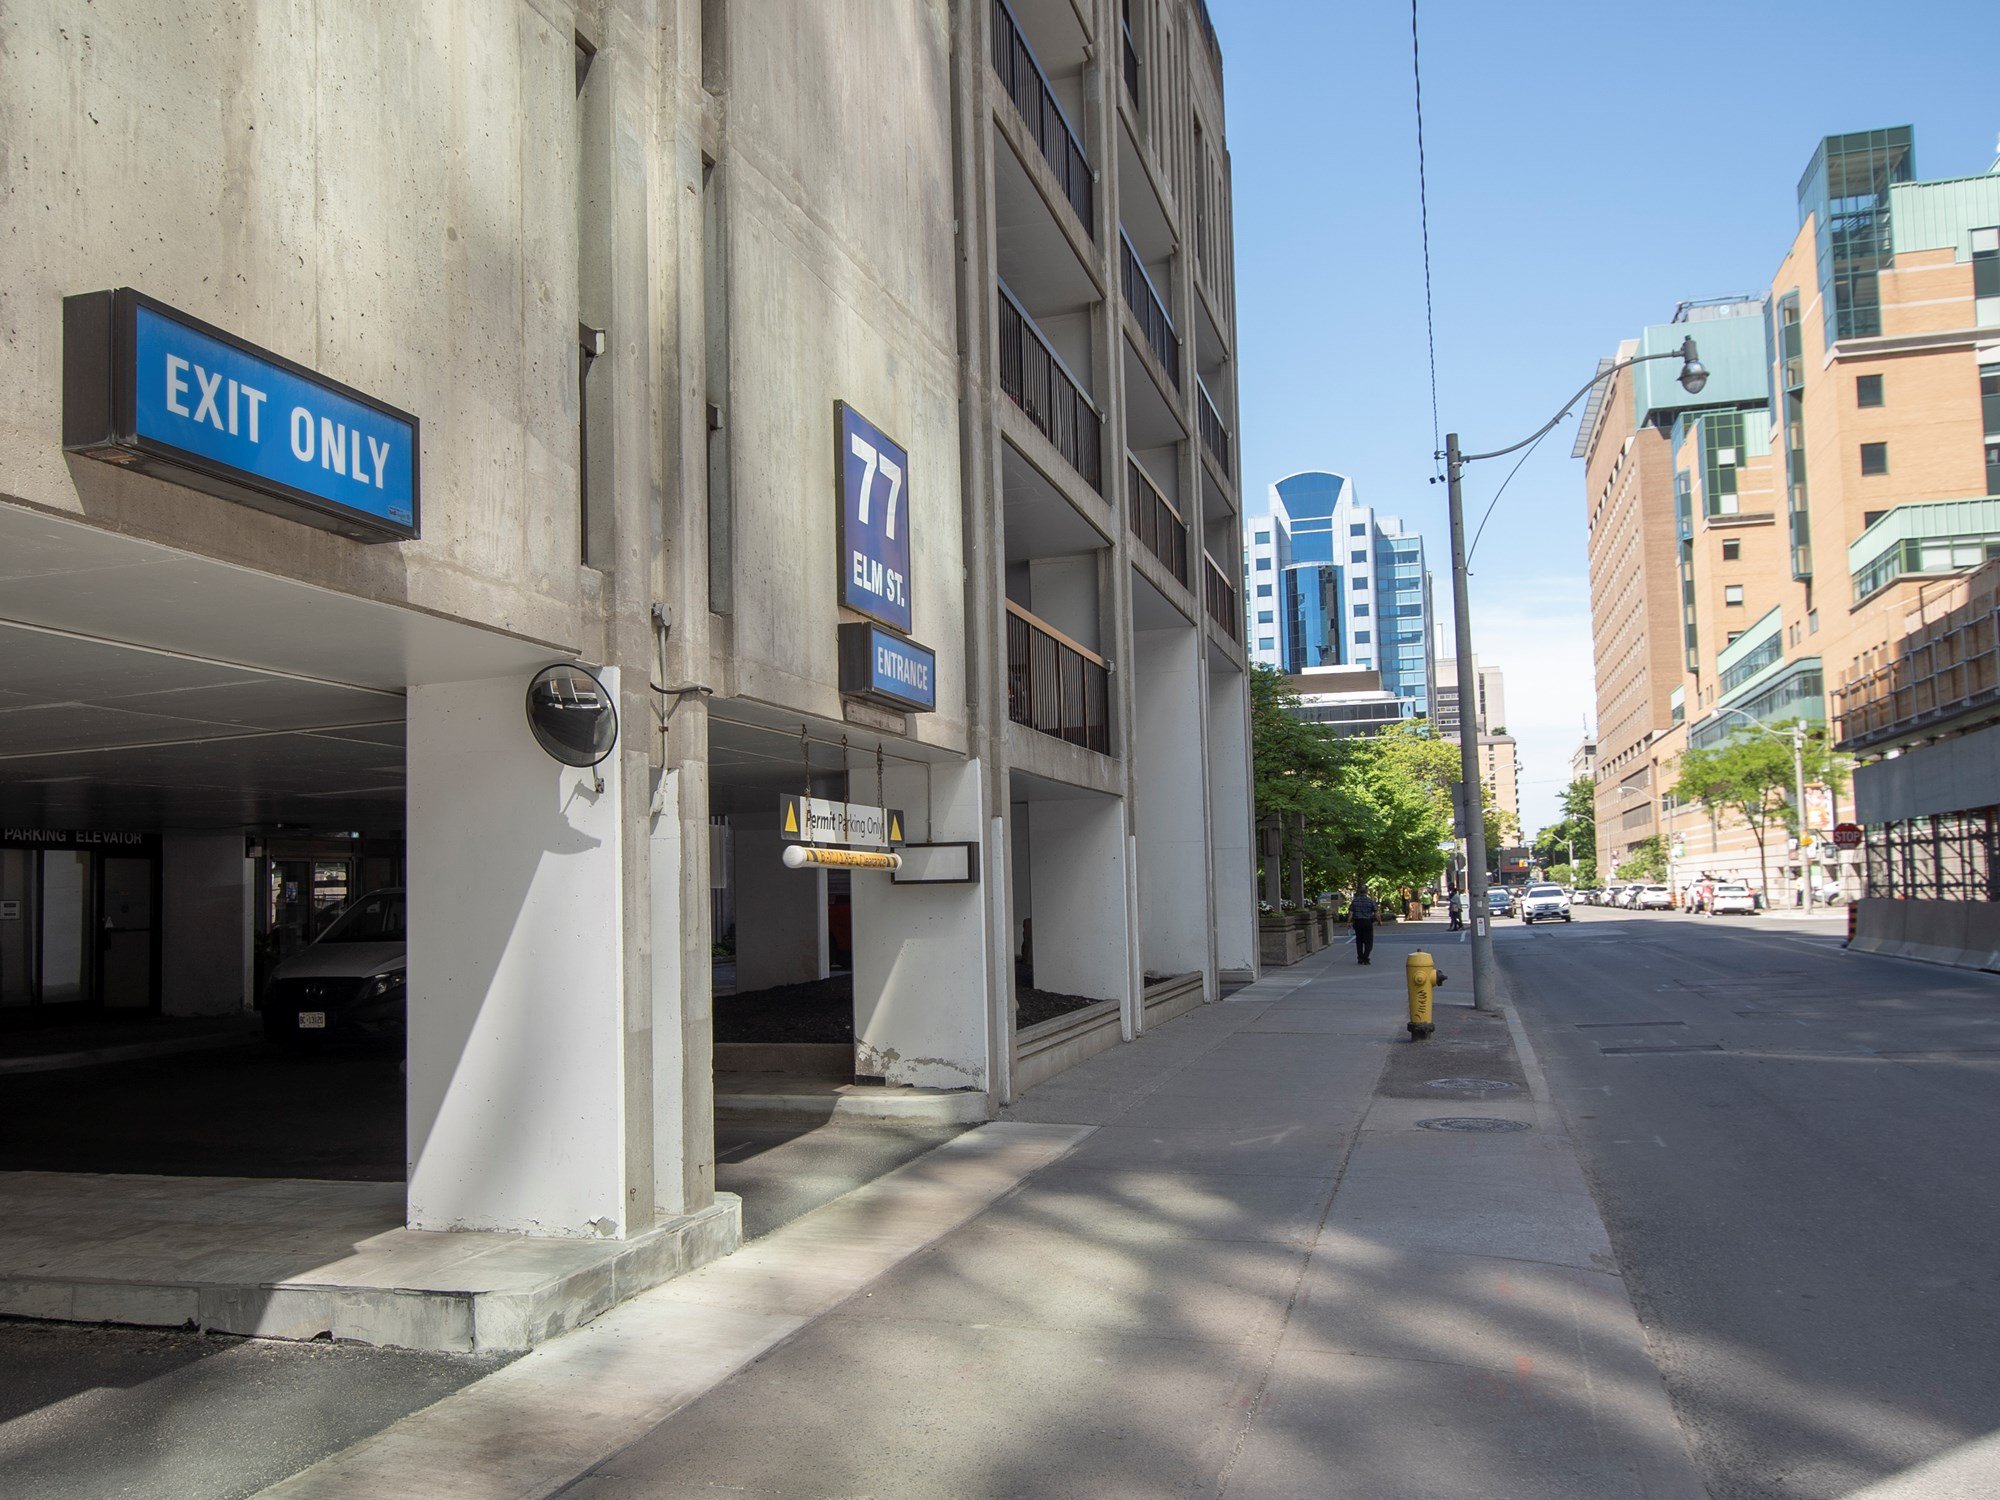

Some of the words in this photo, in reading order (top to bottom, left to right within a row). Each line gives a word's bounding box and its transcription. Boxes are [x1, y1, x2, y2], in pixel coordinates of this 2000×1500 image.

[166, 353, 267, 444] EXIT
[290, 406, 391, 490] ONLY
[850, 431, 902, 542] 77
[852, 549, 884, 598] ELM
[886, 568, 906, 607] ST.
[877, 646, 928, 691] ENTRANCE
[3, 828, 67, 842] PARKING
[75, 830, 143, 845] ELEVATOR
[806, 809, 836, 831] Permit
[867, 816, 882, 840] Only
[1834, 831, 1859, 842] STOP
